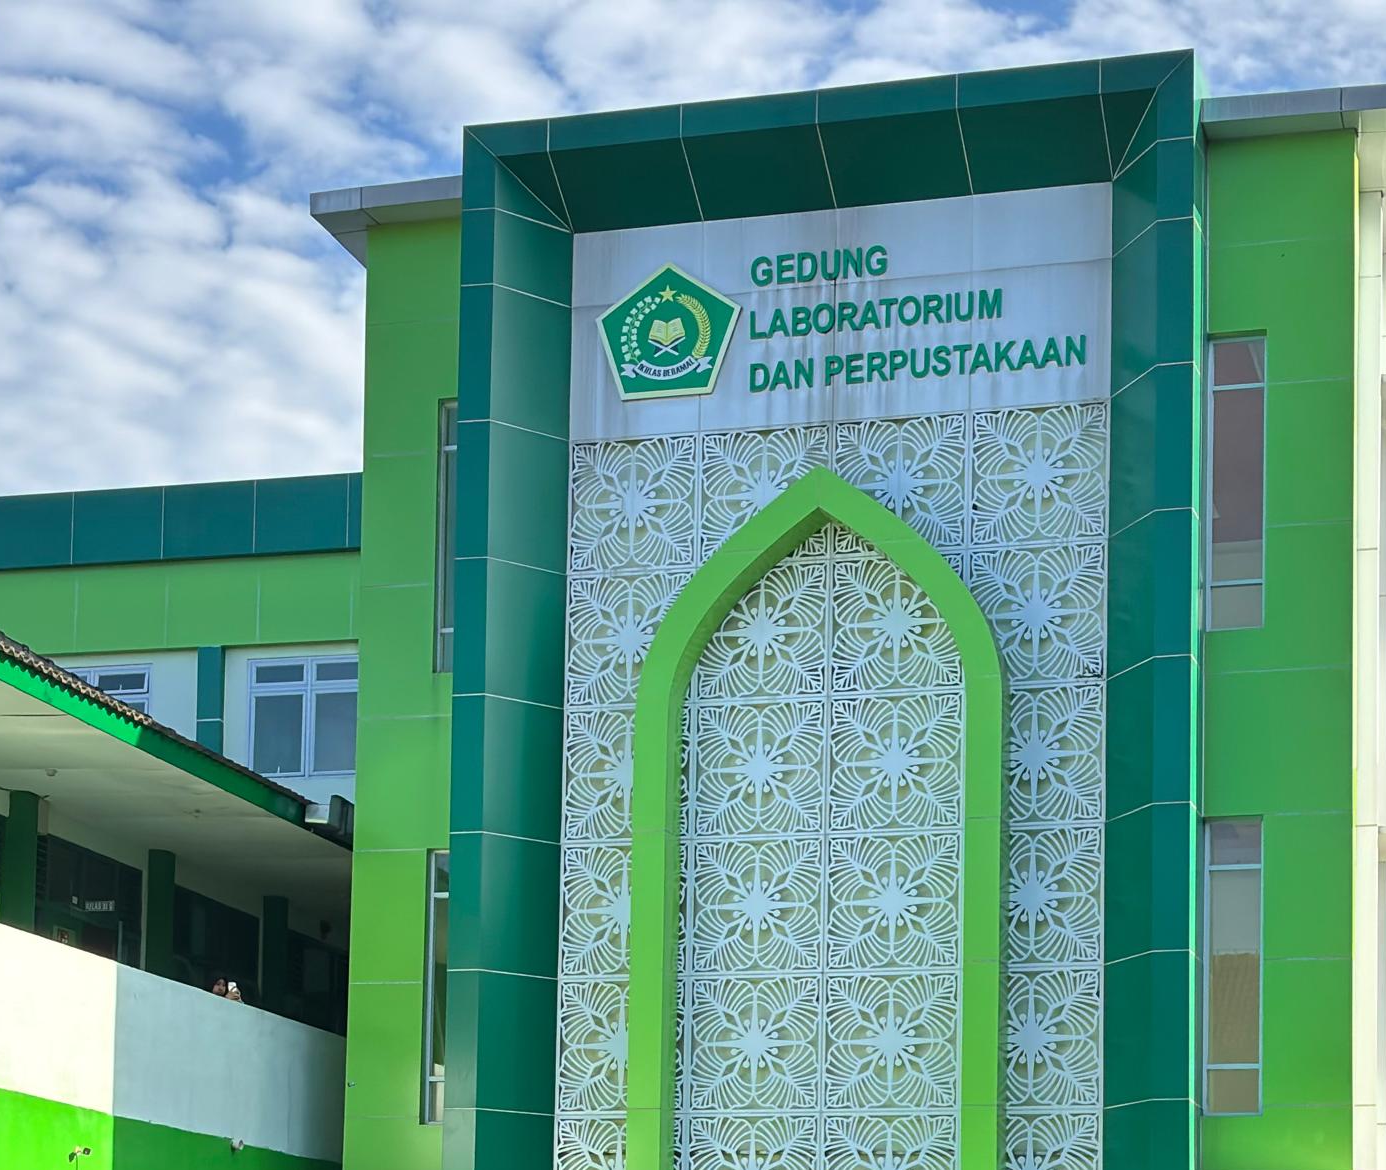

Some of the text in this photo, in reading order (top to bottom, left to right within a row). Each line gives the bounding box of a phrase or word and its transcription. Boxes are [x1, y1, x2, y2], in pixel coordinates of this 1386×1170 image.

[750, 245, 888, 287] GEDUNG
[749, 288, 1003, 340] LABORATORIUM
[749, 334, 1088, 393] DAN PERPUSTAKAAN
